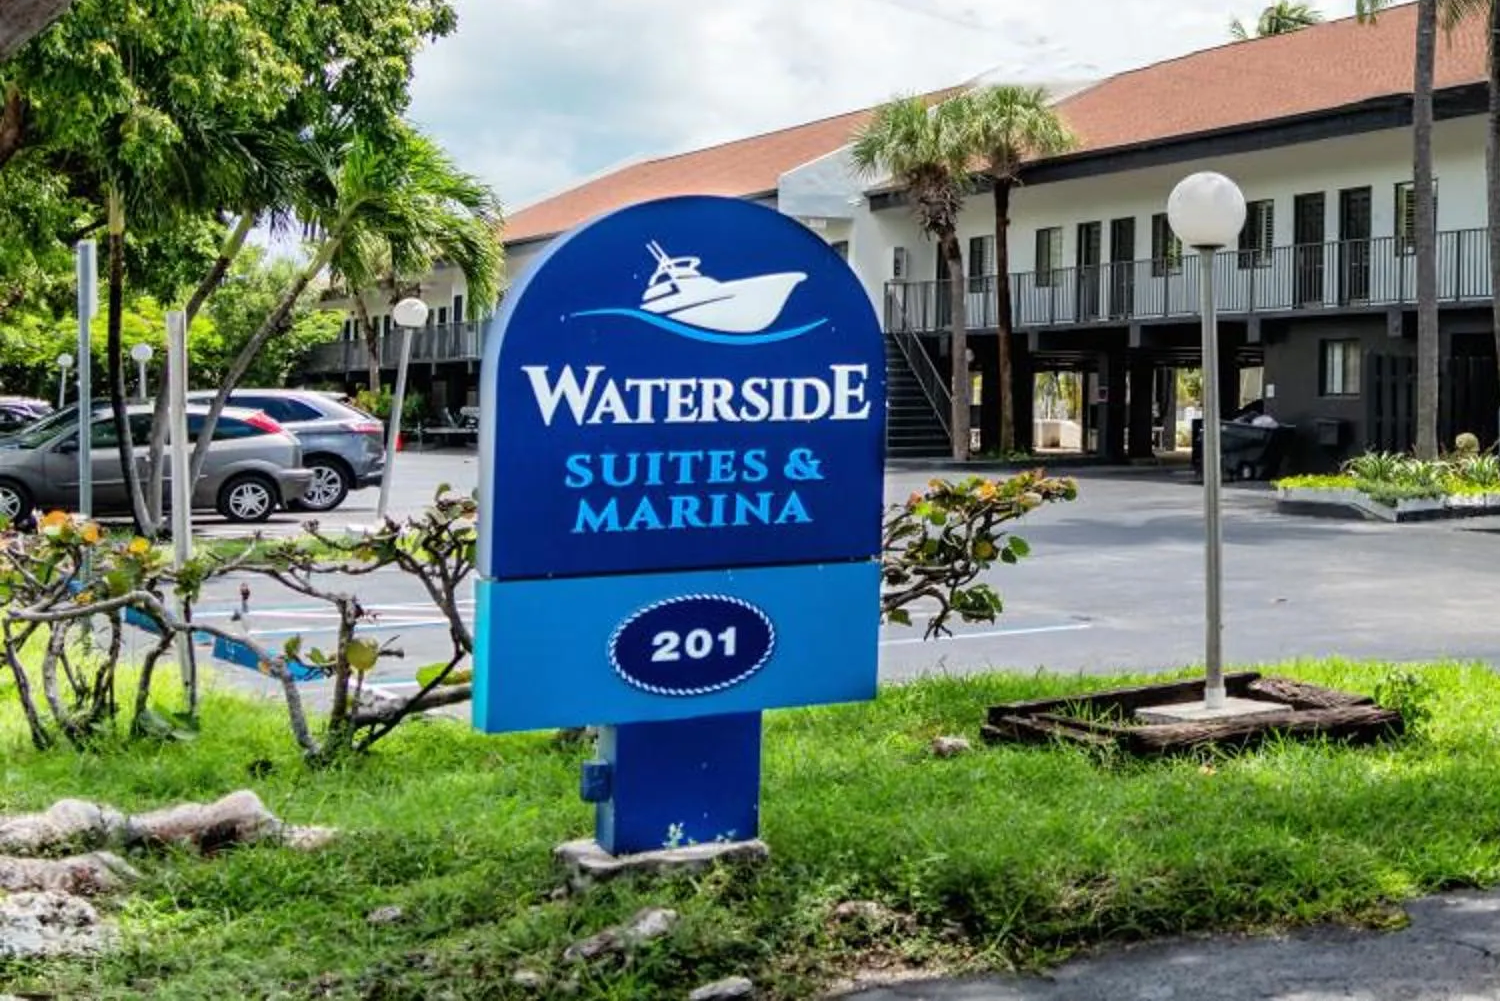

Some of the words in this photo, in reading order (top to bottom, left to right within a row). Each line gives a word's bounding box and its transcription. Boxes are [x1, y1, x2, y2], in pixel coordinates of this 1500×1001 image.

[521, 363, 872, 426] WATERSIDE
[564, 449, 769, 488] SUITES
[783, 448, 826, 481] &
[570, 490, 813, 534] MARINA
[651, 626, 737, 662] 201
